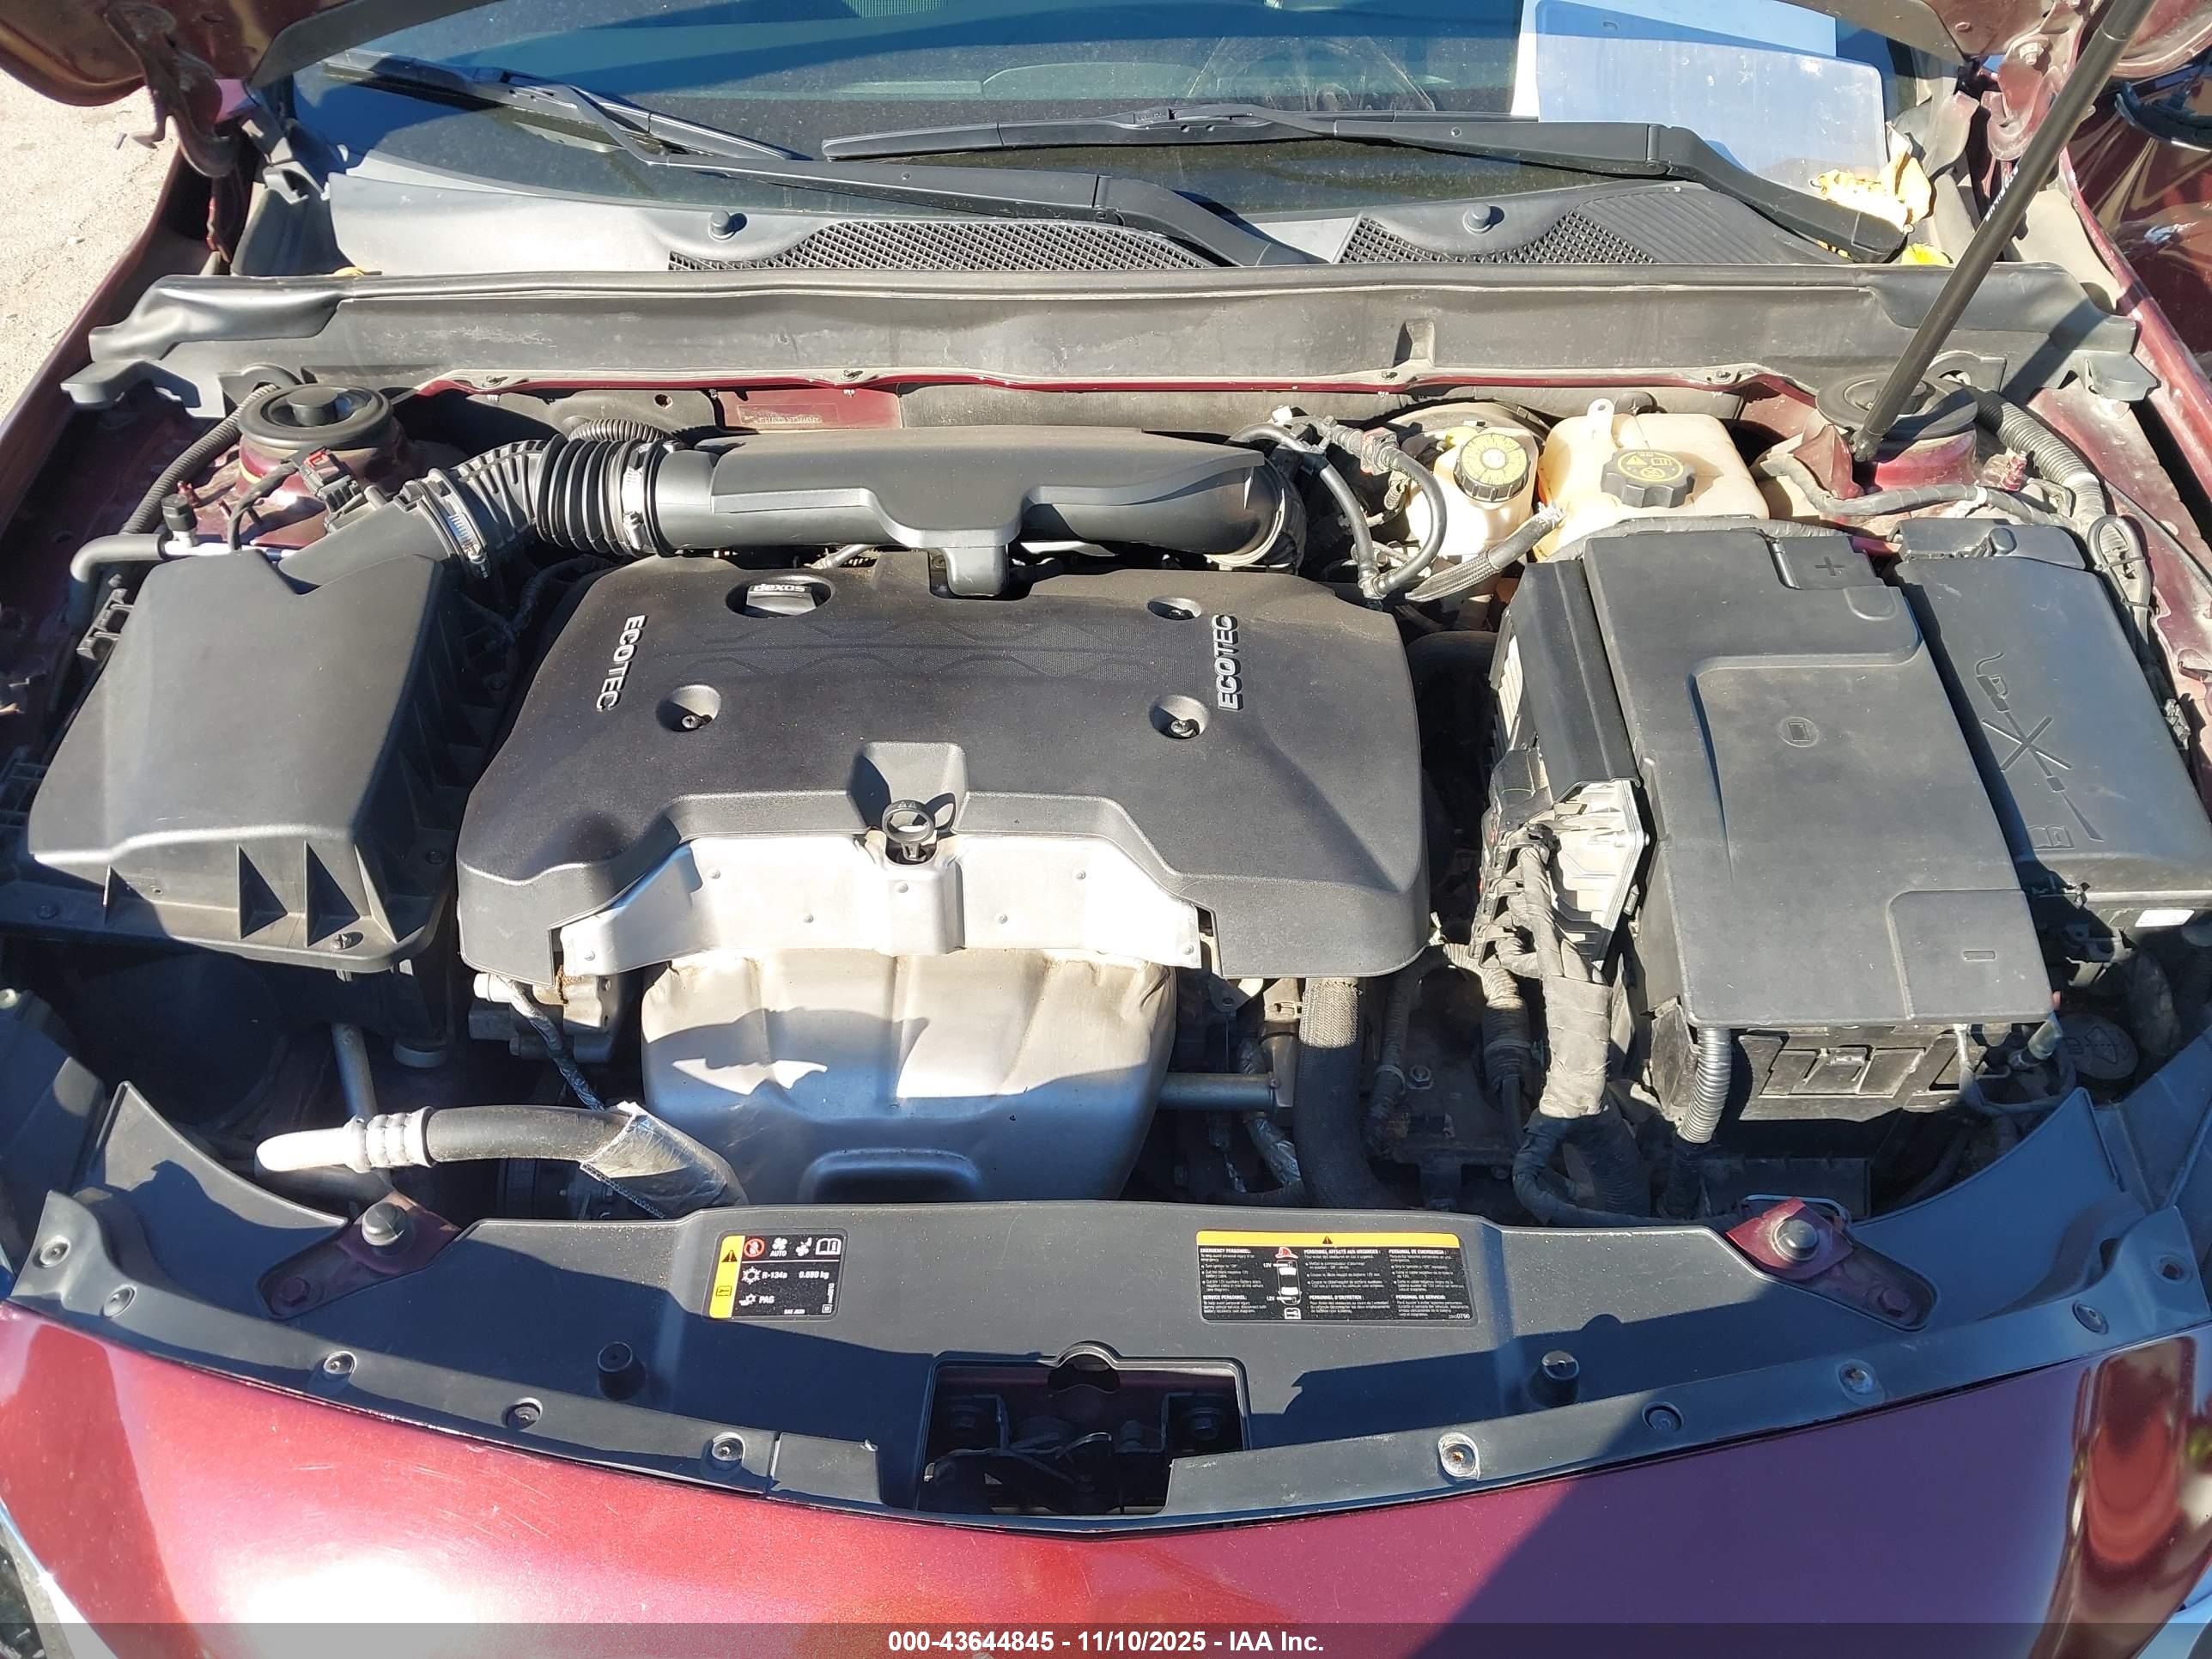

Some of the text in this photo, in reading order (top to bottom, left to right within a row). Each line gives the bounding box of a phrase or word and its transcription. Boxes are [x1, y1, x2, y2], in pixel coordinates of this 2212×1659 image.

[753, 583, 805, 592] dexos
[596, 614, 646, 711] ECOTEC
[1212, 614, 1241, 710] ECOTEC
[762, 1271, 788, 1279] R-134a
